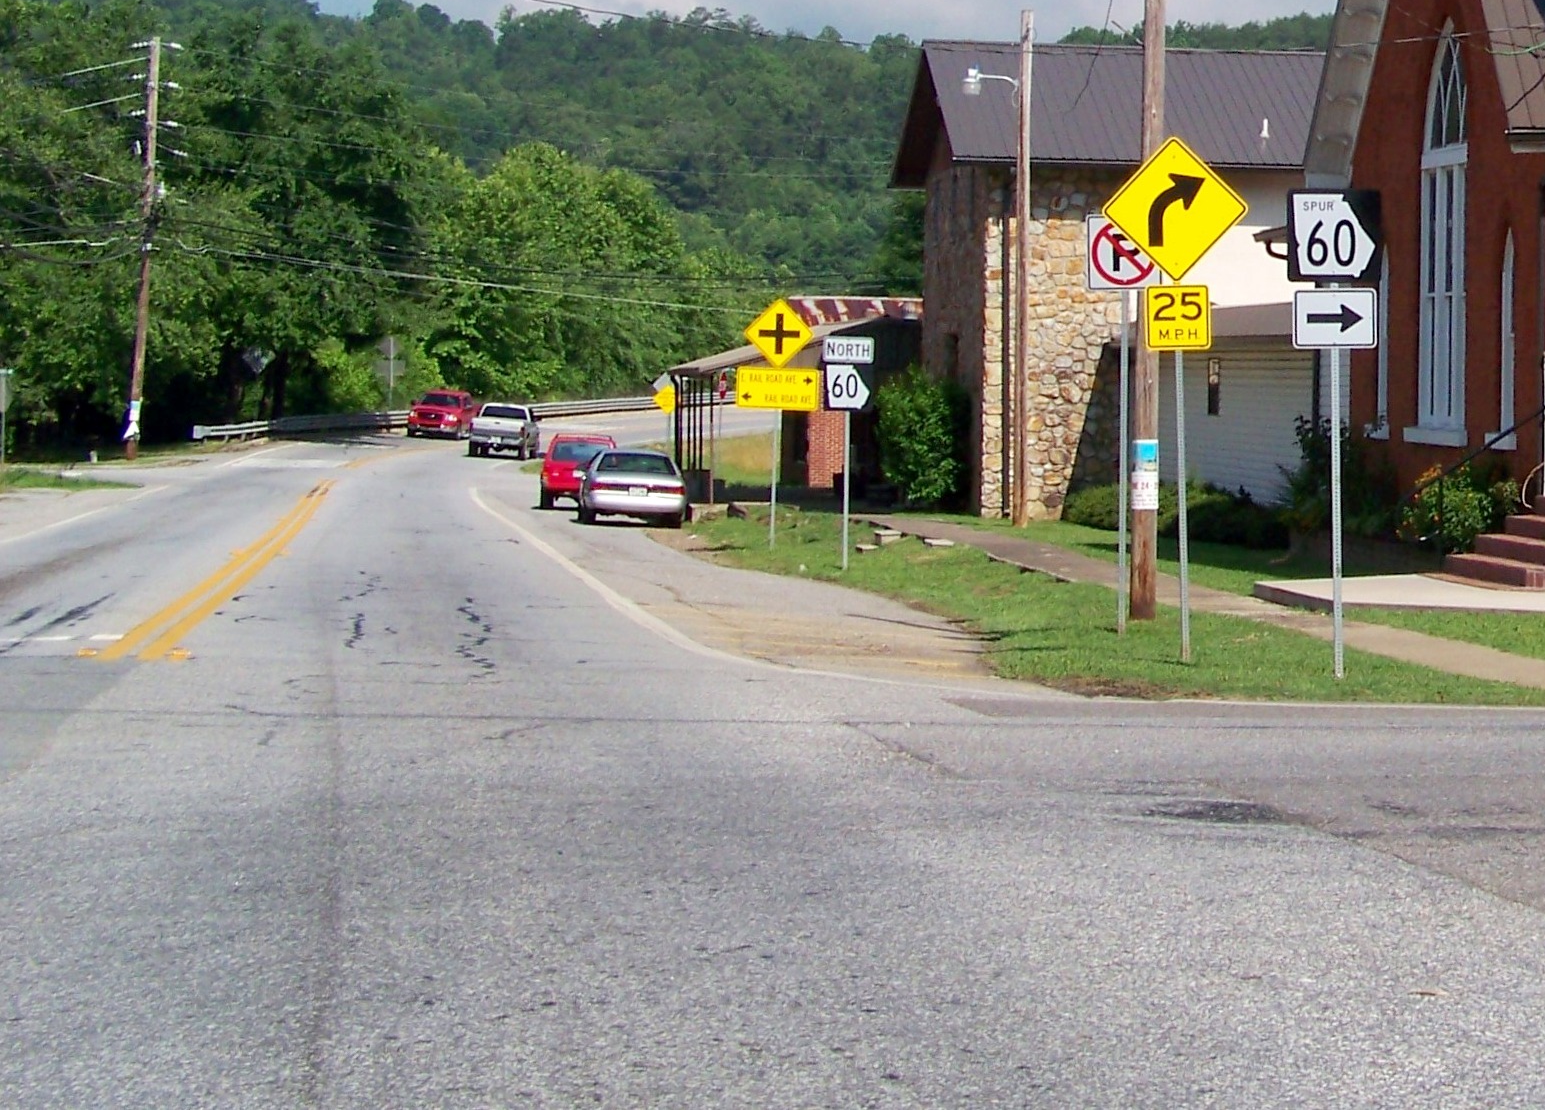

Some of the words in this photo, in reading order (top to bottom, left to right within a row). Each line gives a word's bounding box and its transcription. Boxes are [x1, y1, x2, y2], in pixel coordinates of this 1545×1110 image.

[1302, 200, 1334, 211] SPUR
[1306, 219, 1356, 267] 60
[1153, 292, 1202, 321] 25
[826, 341, 871, 358] NORTH
[831, 374, 858, 398] 60
